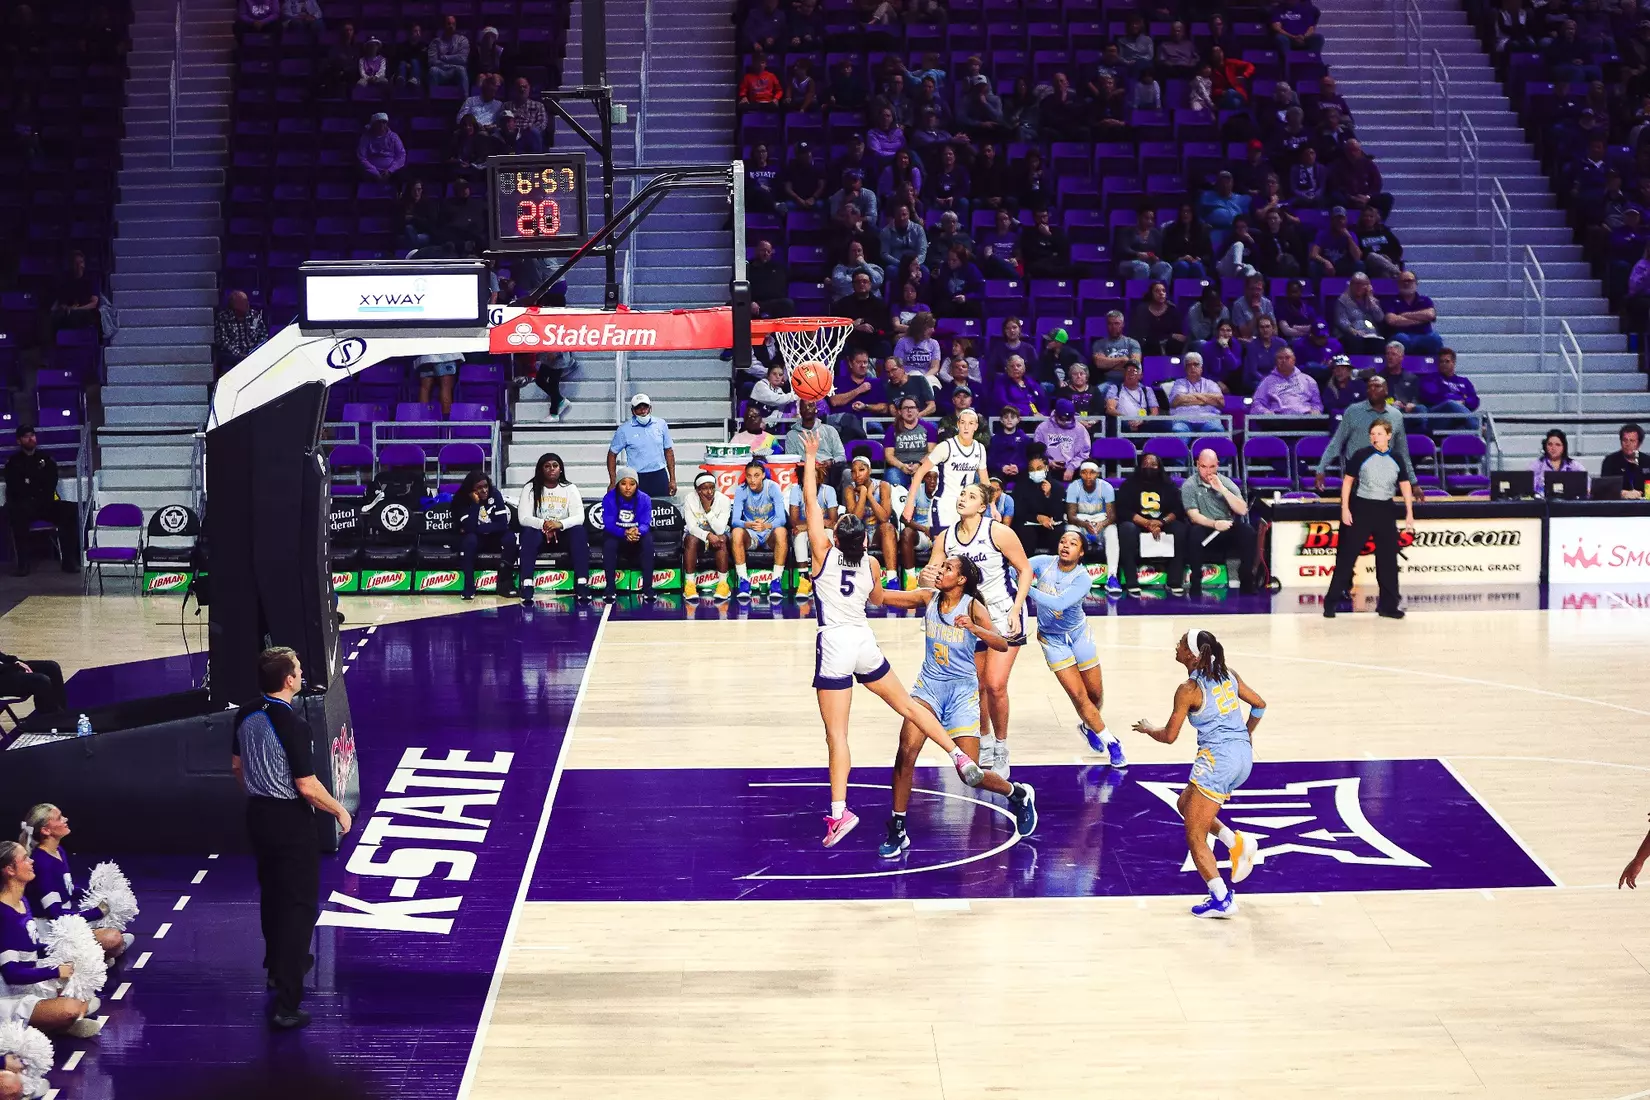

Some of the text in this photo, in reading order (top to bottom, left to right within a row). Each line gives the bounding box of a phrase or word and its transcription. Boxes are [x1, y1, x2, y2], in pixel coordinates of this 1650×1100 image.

[517, 168, 574, 194] 6:57
[517, 200, 560, 235] 20
[359, 294, 425, 306] XYWAY
[961, 474, 968, 489] 4
[1407, 564, 1484, 573] PROFESSIONAL
[1487, 564, 1522, 573] GRADE
[148, 574, 185, 590] LIBMAN
[366, 573, 402, 588] LIBMAN
[420, 573, 456, 590] LIBMAN
[840, 570, 856, 597] 5
[1212, 680, 1238, 715] 25
[315, 747, 514, 935] K-STATE
